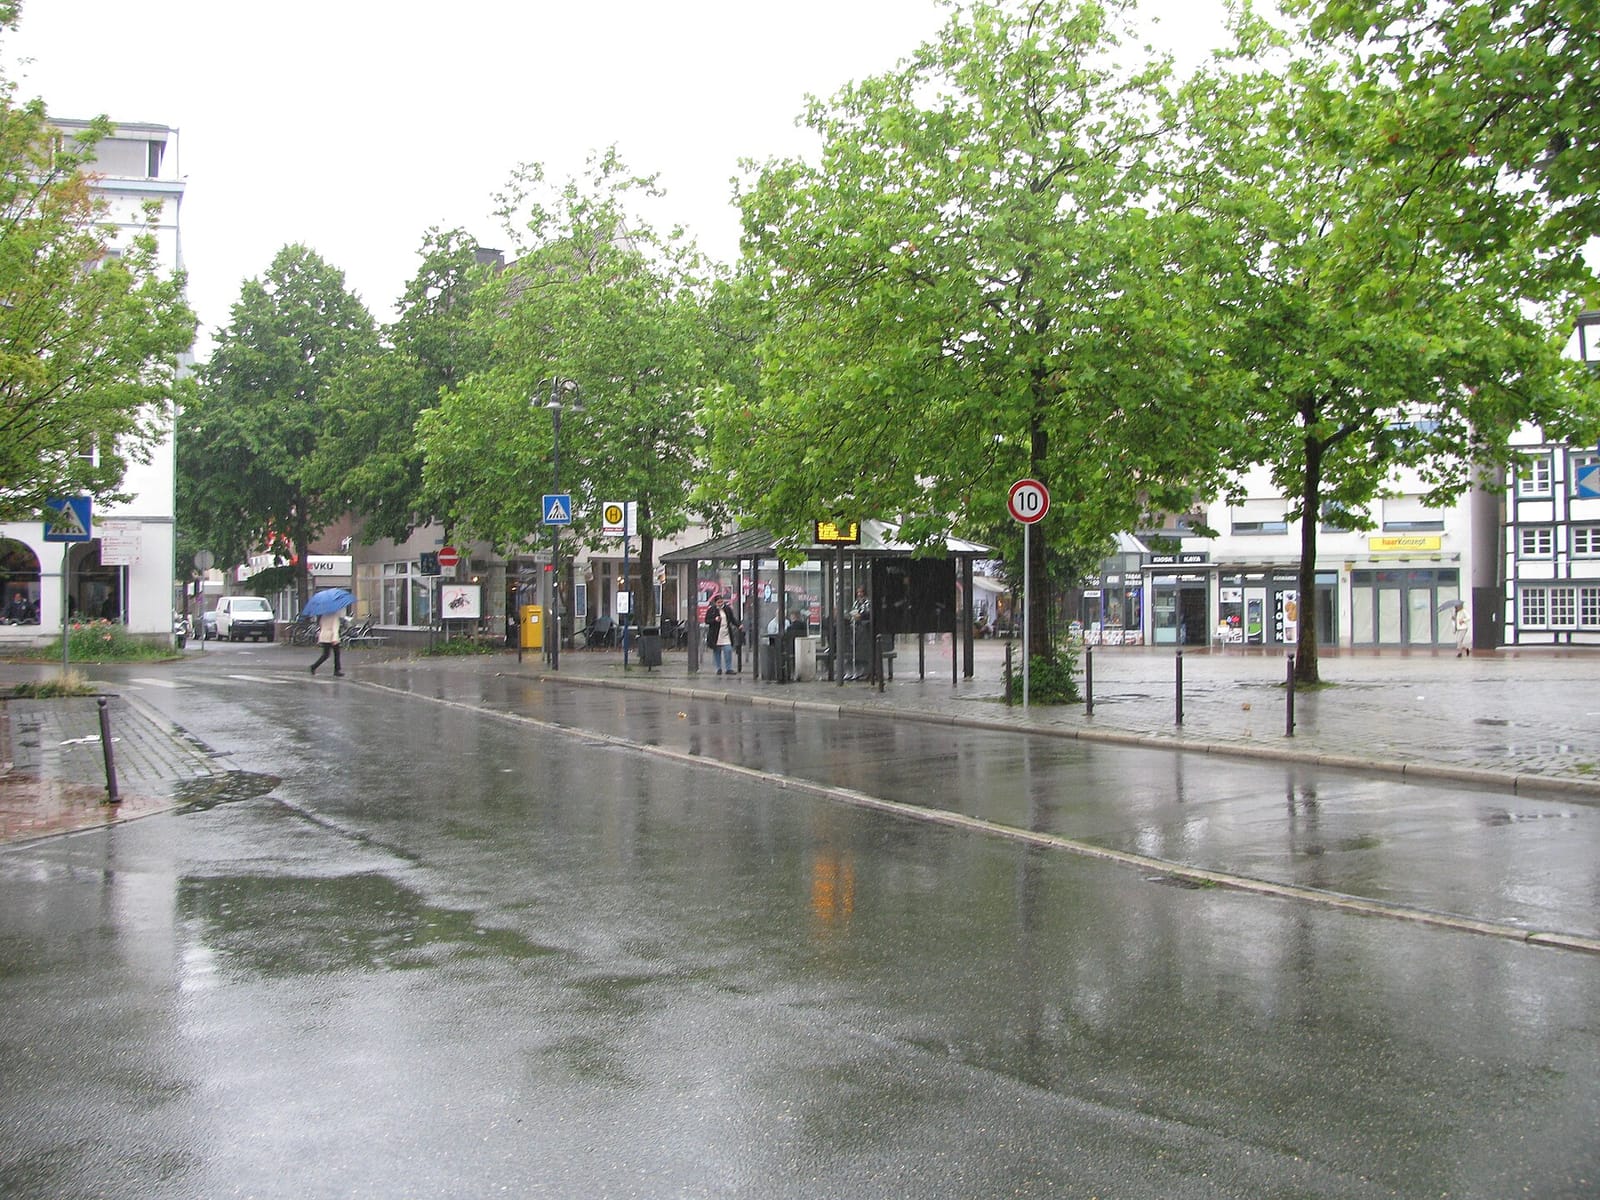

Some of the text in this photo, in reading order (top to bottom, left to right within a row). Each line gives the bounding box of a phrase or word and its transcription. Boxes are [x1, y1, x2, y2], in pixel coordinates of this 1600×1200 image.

[1018, 491, 1038, 511] 10
[609, 508, 618, 520] H
[1275, 591, 1283, 641] KIOSK
